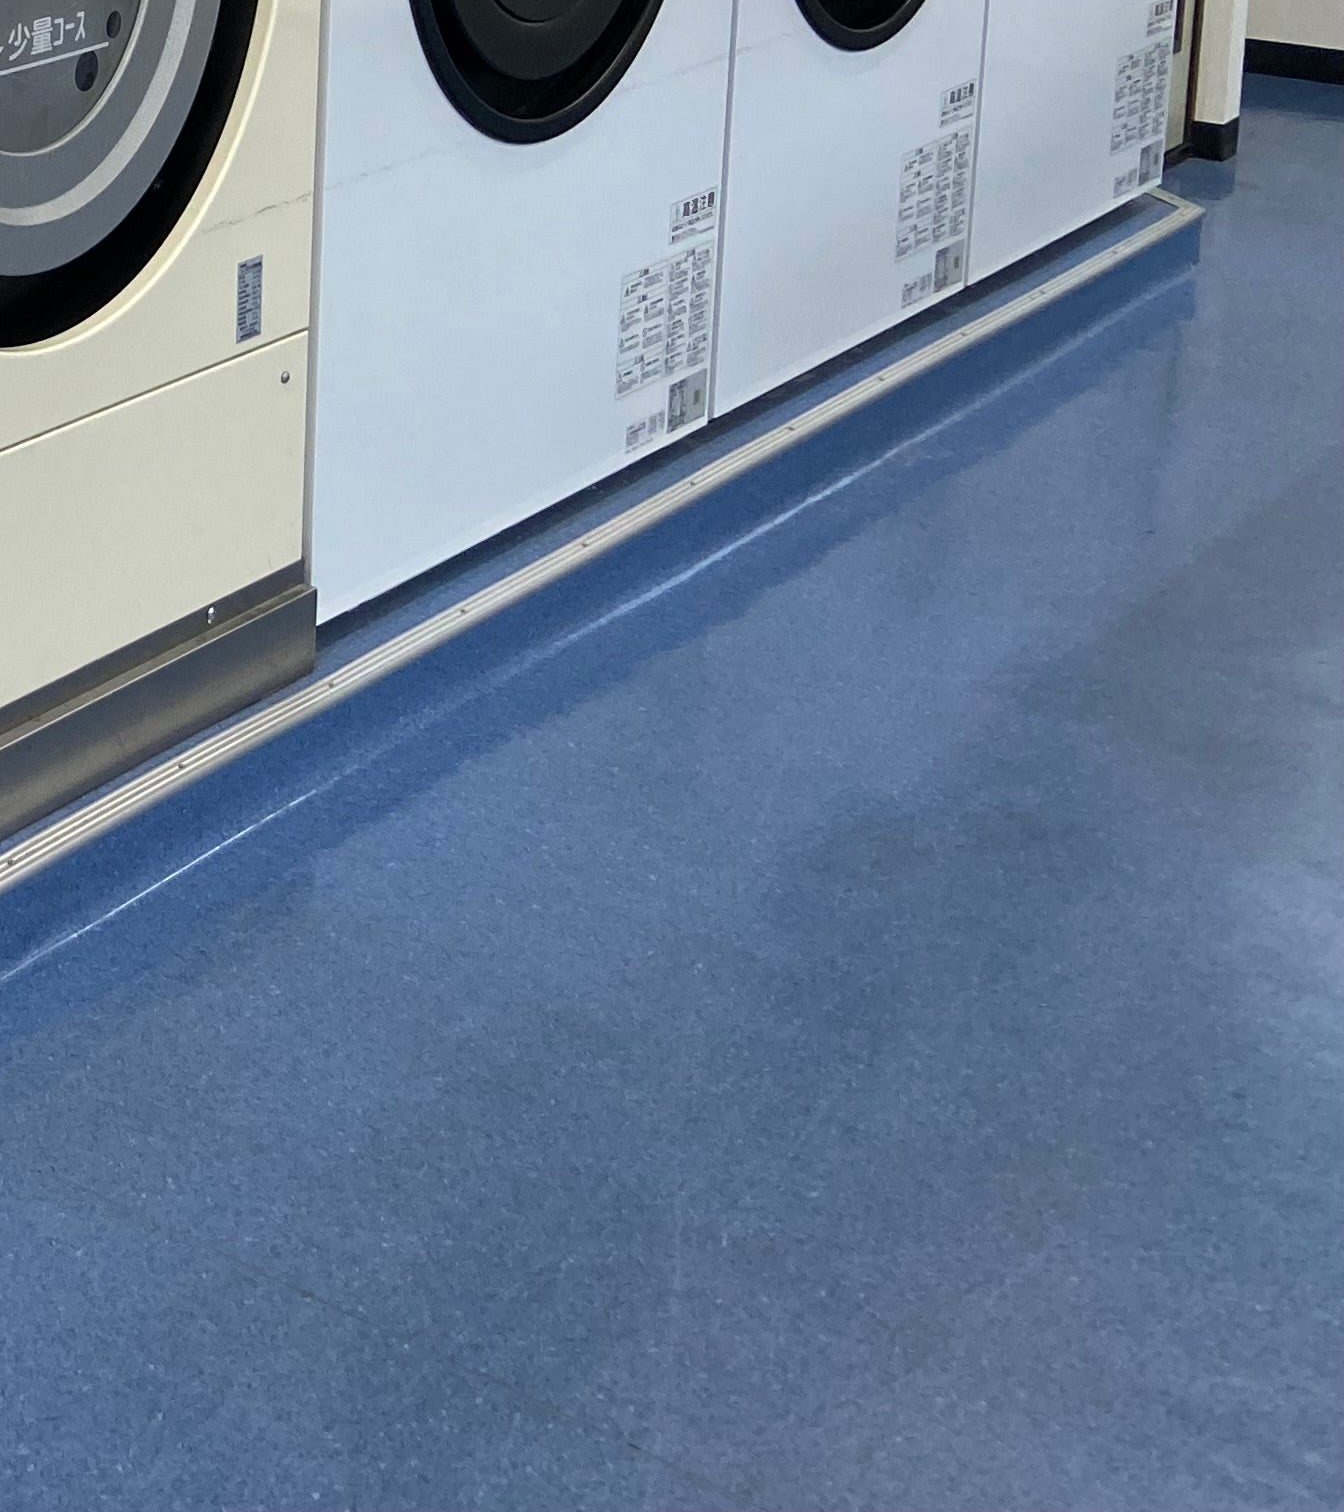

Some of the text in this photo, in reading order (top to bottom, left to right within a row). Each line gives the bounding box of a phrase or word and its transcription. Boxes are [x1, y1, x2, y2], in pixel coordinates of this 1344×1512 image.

[7, 10, 87, 63] 少量コース
